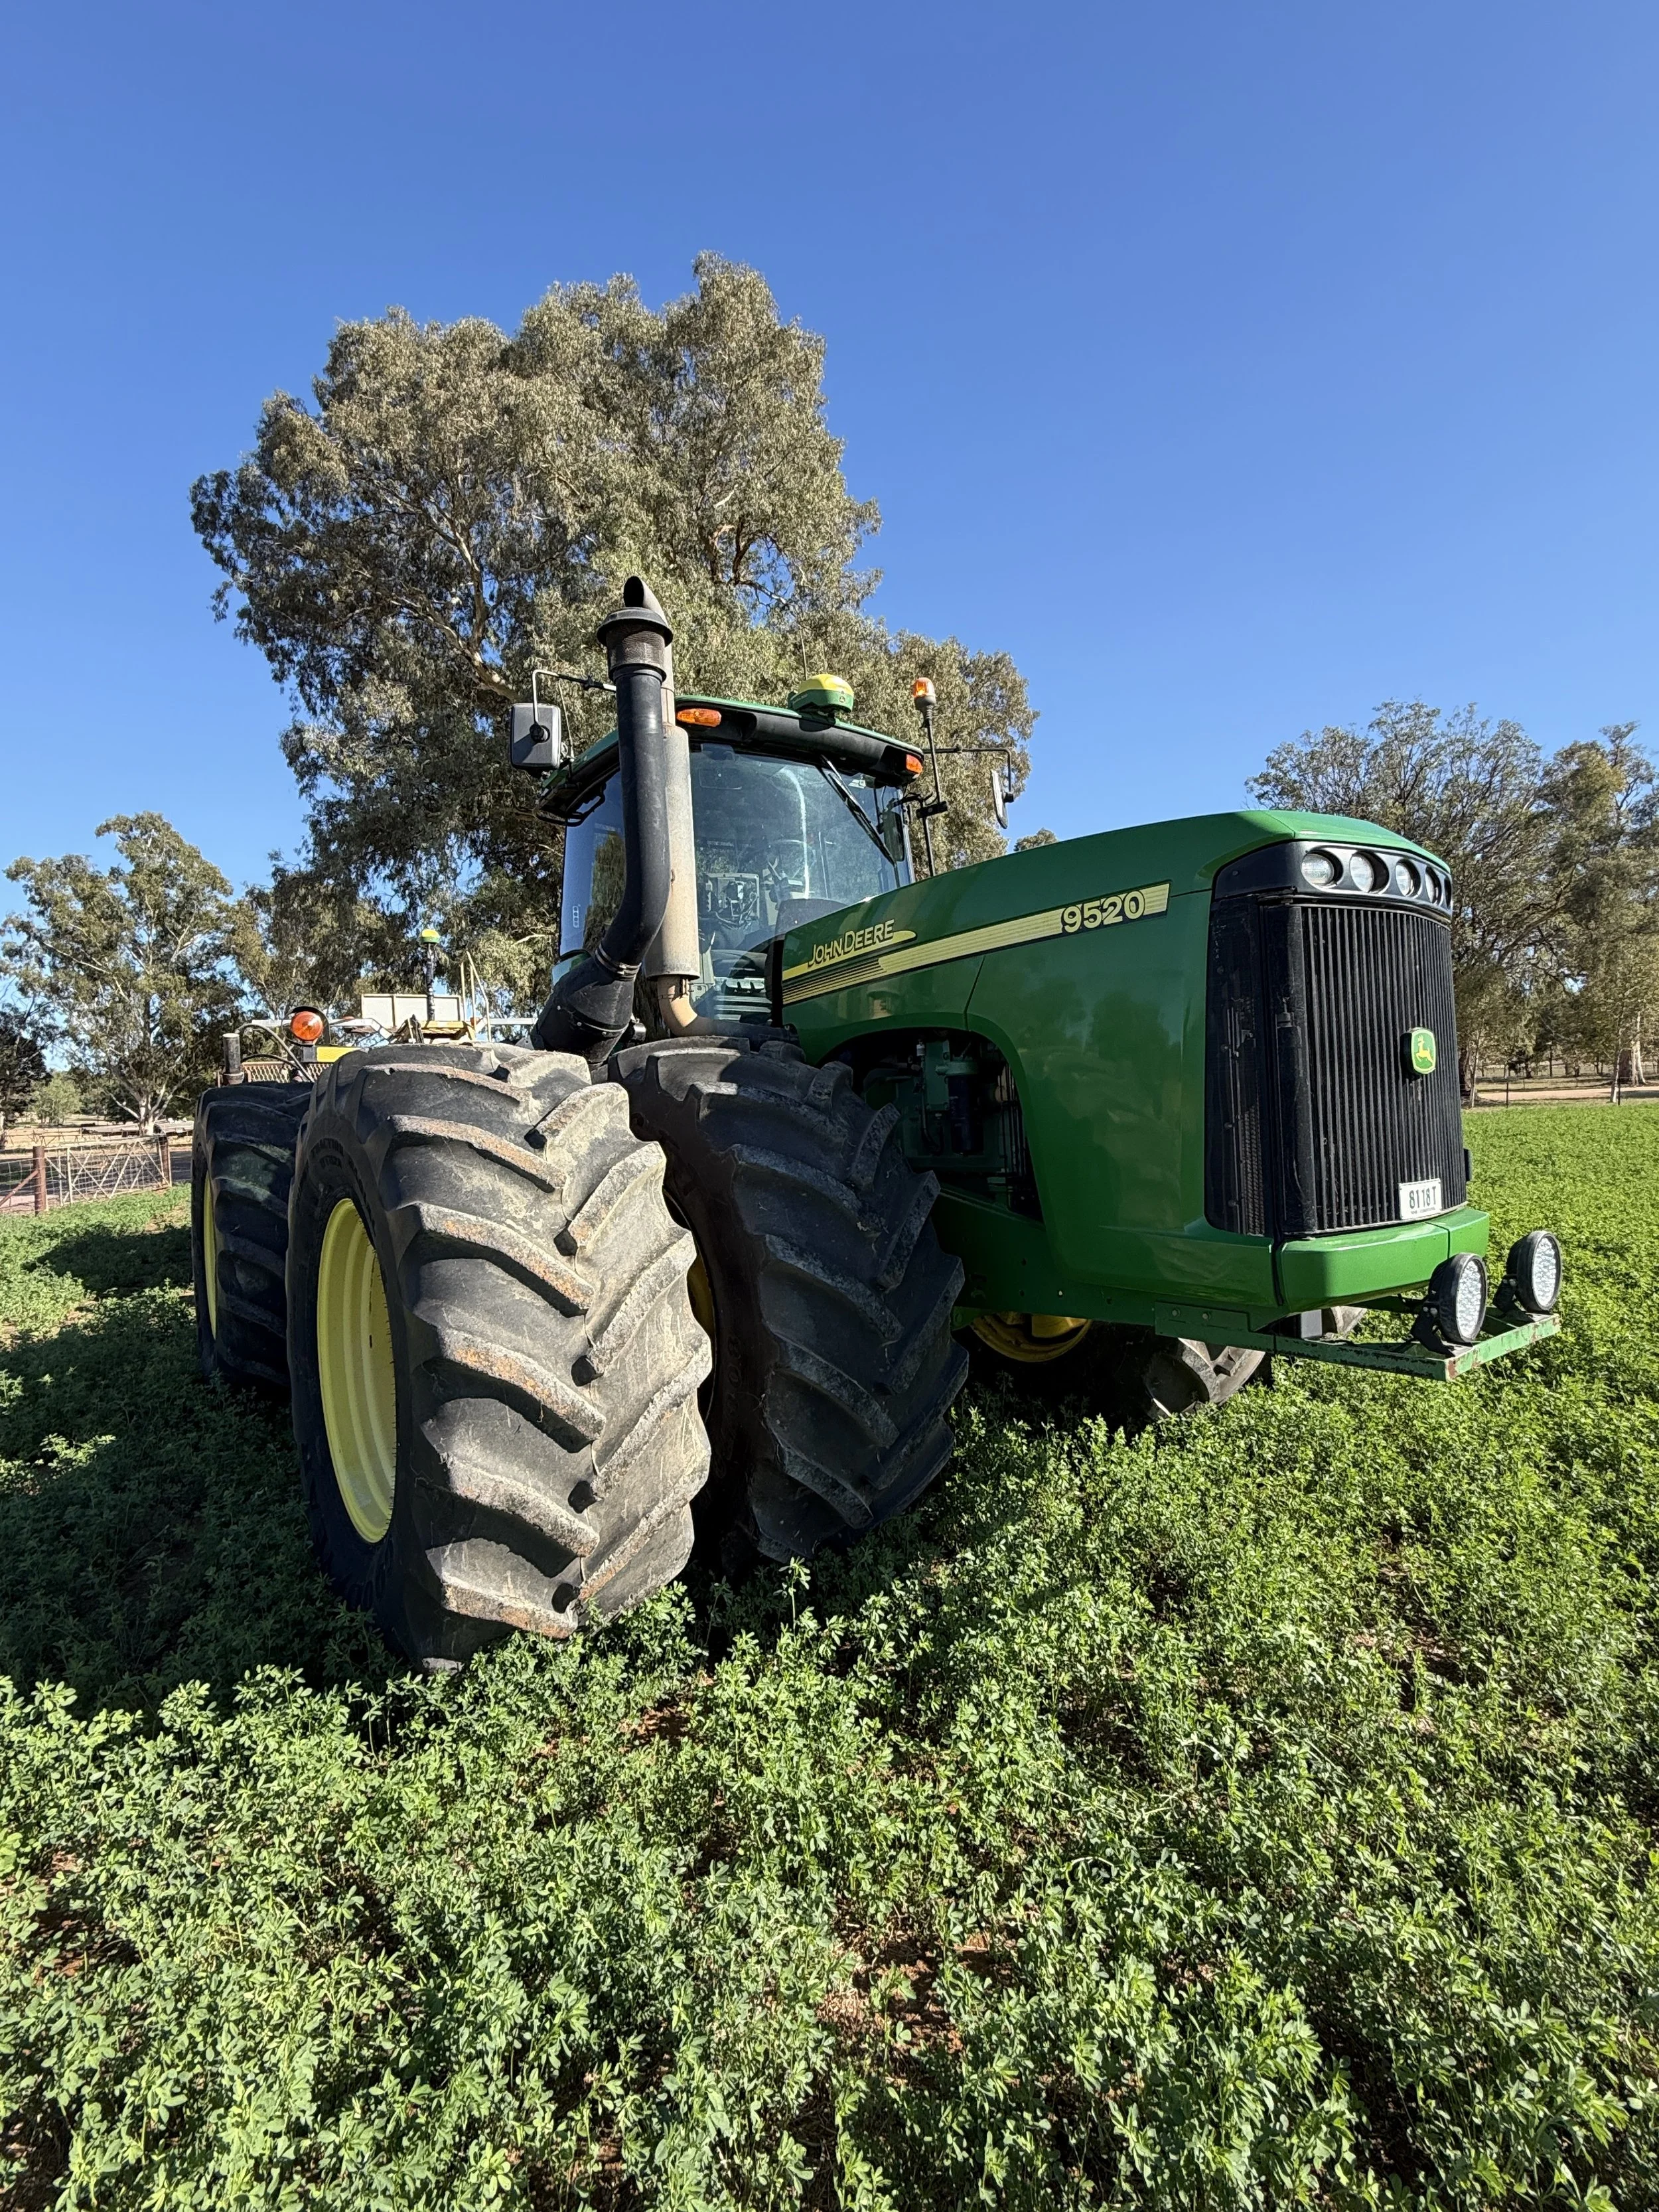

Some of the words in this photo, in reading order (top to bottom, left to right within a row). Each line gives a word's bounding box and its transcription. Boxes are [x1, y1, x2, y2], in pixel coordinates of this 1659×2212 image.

[1061, 890, 1145, 933] 9520
[808, 938, 843, 967] JOHN
[843, 919, 895, 954] DEERE
[1408, 1185, 1437, 1209] 8118T
